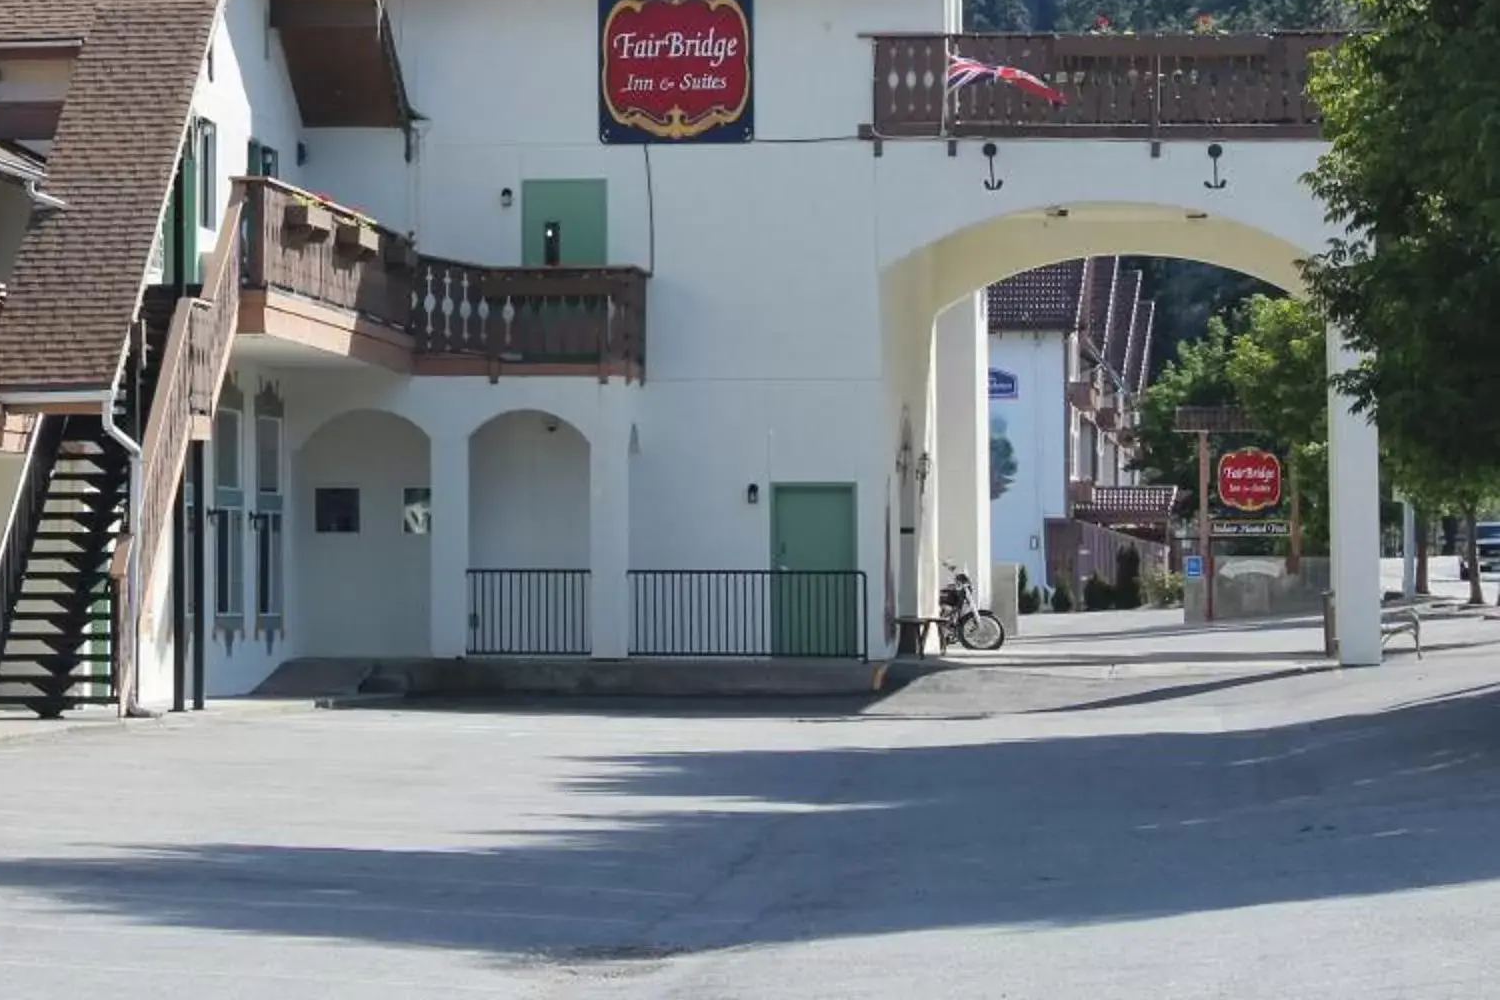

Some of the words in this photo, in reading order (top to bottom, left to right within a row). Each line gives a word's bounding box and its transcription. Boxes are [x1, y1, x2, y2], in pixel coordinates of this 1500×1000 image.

[613, 27, 738, 67] FairBridge
[620, 74, 654, 92] Inn
[660, 79, 675, 91] &
[680, 73, 727, 91] Suites
